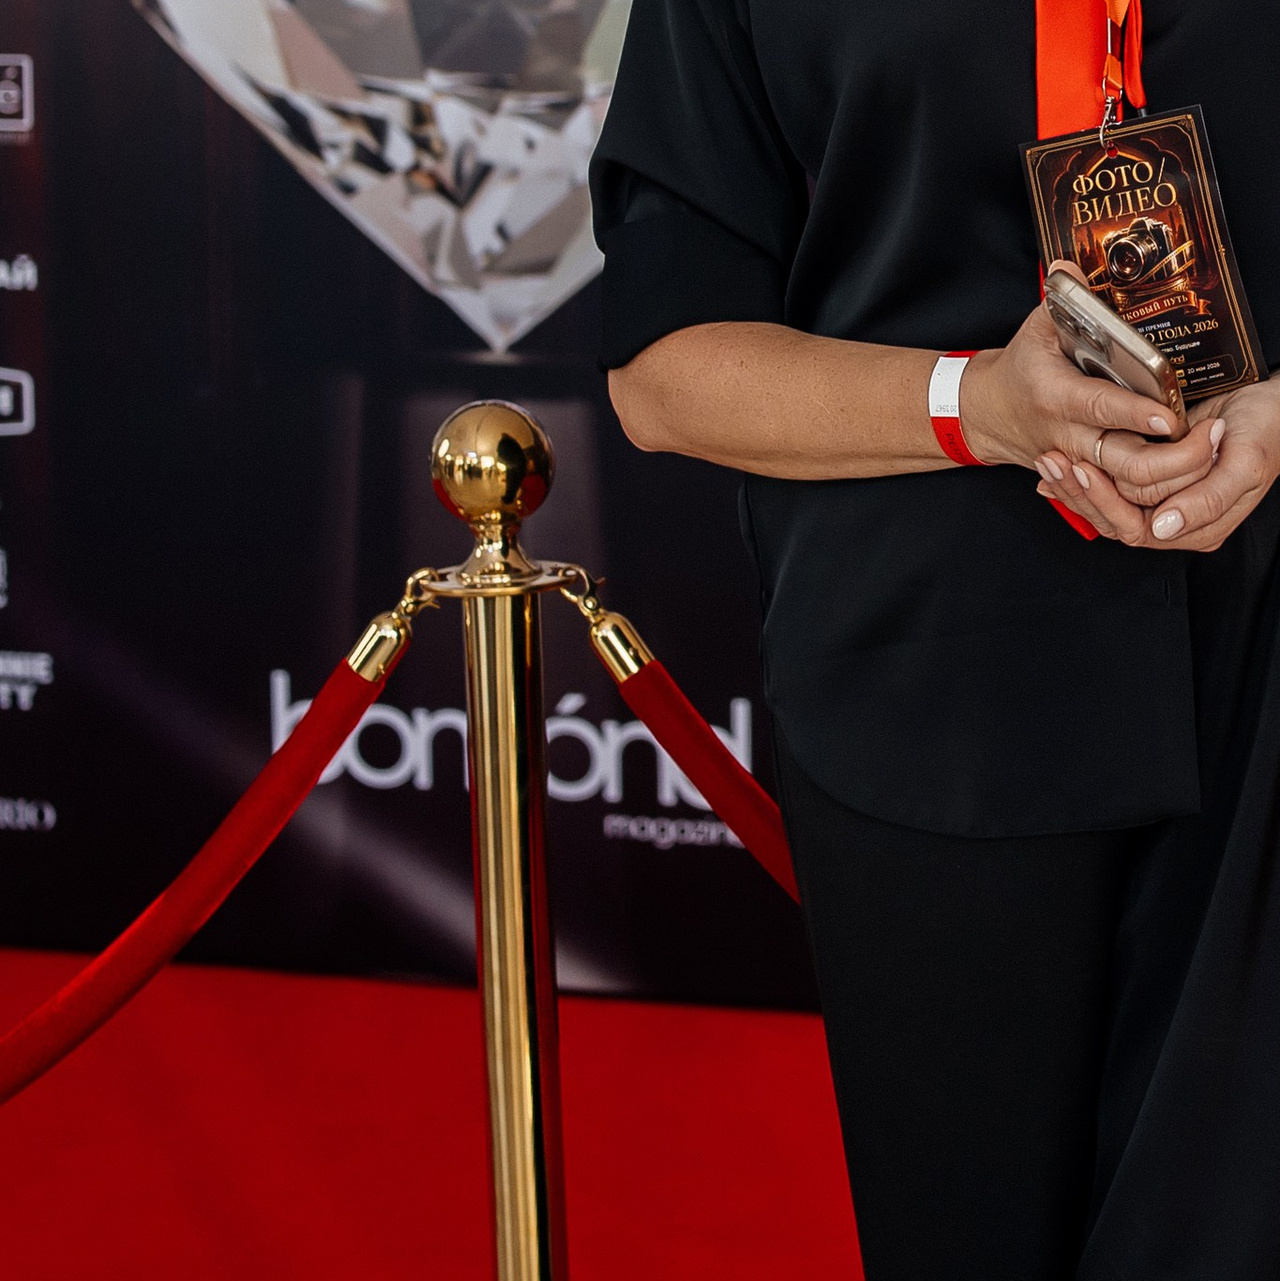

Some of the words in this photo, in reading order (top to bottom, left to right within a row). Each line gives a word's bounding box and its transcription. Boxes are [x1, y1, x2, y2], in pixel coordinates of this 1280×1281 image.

[1072, 181, 1178, 226] ВИДЕО
[1163, 294, 1189, 308] ПУТЬ
[1158, 324, 1192, 342] ГОДА
[1193, 318, 1219, 333] 2026
